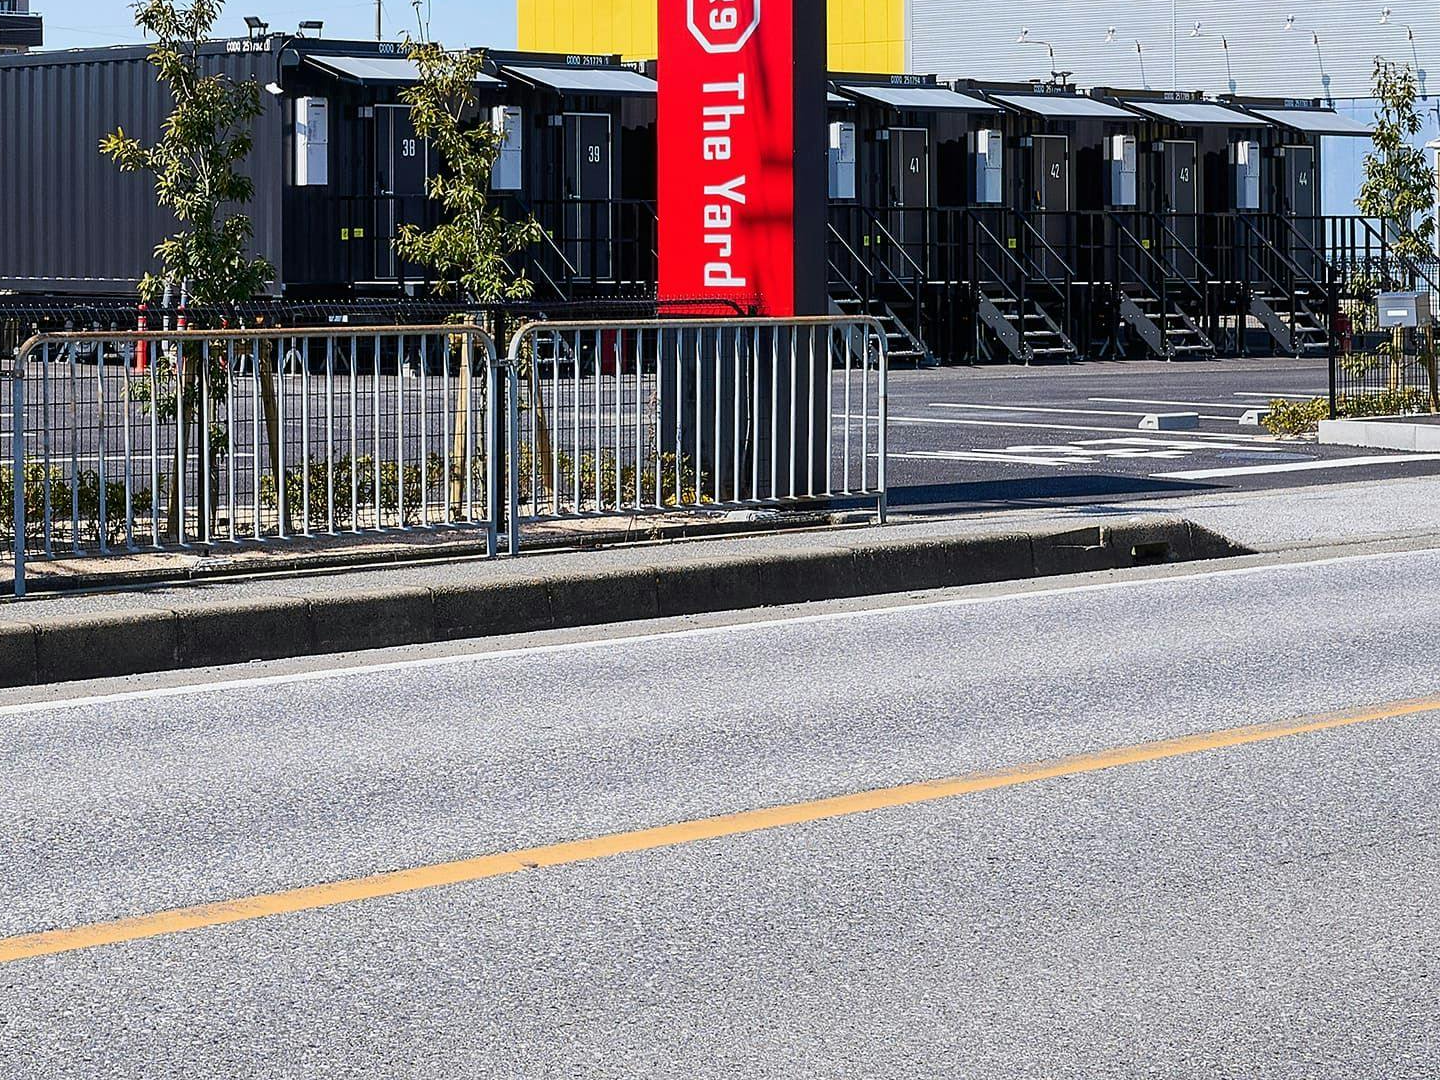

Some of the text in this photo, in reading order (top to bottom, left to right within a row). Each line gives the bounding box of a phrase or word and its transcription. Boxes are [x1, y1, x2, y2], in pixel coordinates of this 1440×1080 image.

[702, 72, 745, 161] The
[402, 139, 416, 157] 38
[588, 145, 600, 163] 39
[910, 157, 919, 174] 41
[1050, 163, 1060, 179] 42
[1179, 167, 1189, 182] 43
[1298, 171, 1308, 186] 44
[703, 174, 747, 287] Yard
